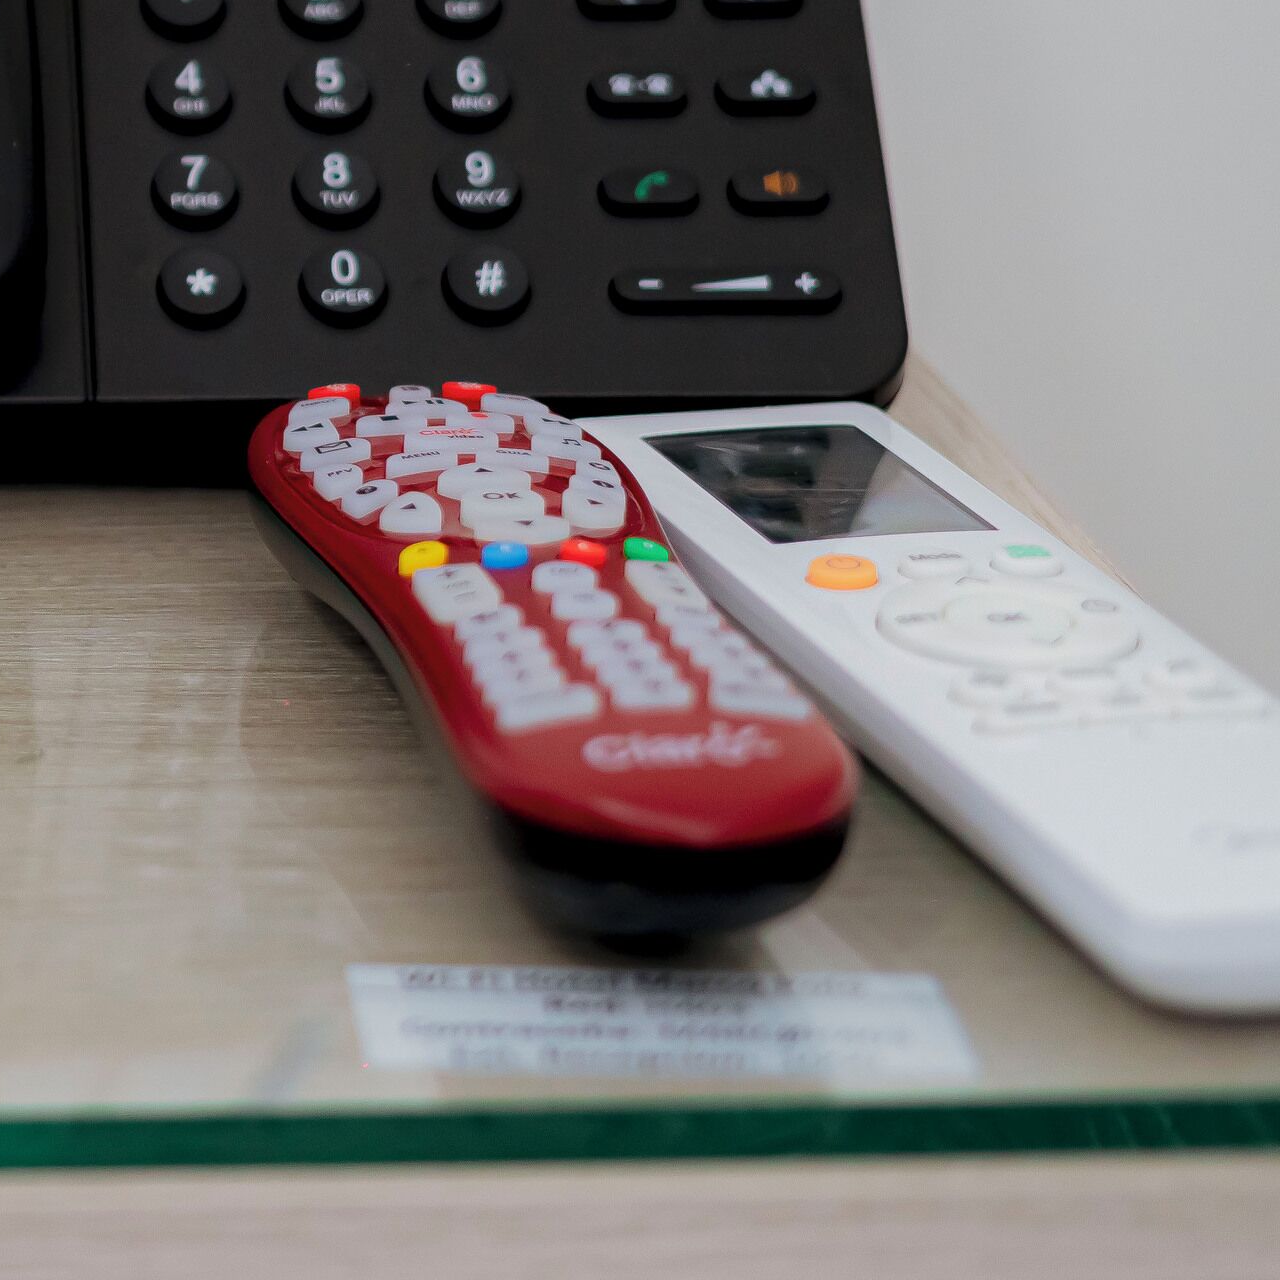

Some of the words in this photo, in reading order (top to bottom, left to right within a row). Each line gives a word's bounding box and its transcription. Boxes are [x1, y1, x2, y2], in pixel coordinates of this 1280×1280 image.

[174, 59, 203, 95] 4
[315, 57, 345, 94] 5
[456, 56, 487, 93] 6
[180, 154, 209, 191] 7
[322, 152, 351, 189] 8
[465, 150, 496, 188] 9
[319, 190, 358, 208] TUV
[330, 249, 360, 286] 0
[475, 261, 506, 296] #
[321, 288, 374, 305] OPER
[327, 467, 353, 478] PPV
[401, 450, 441, 460] MENU
[482, 491, 522, 500] OK
